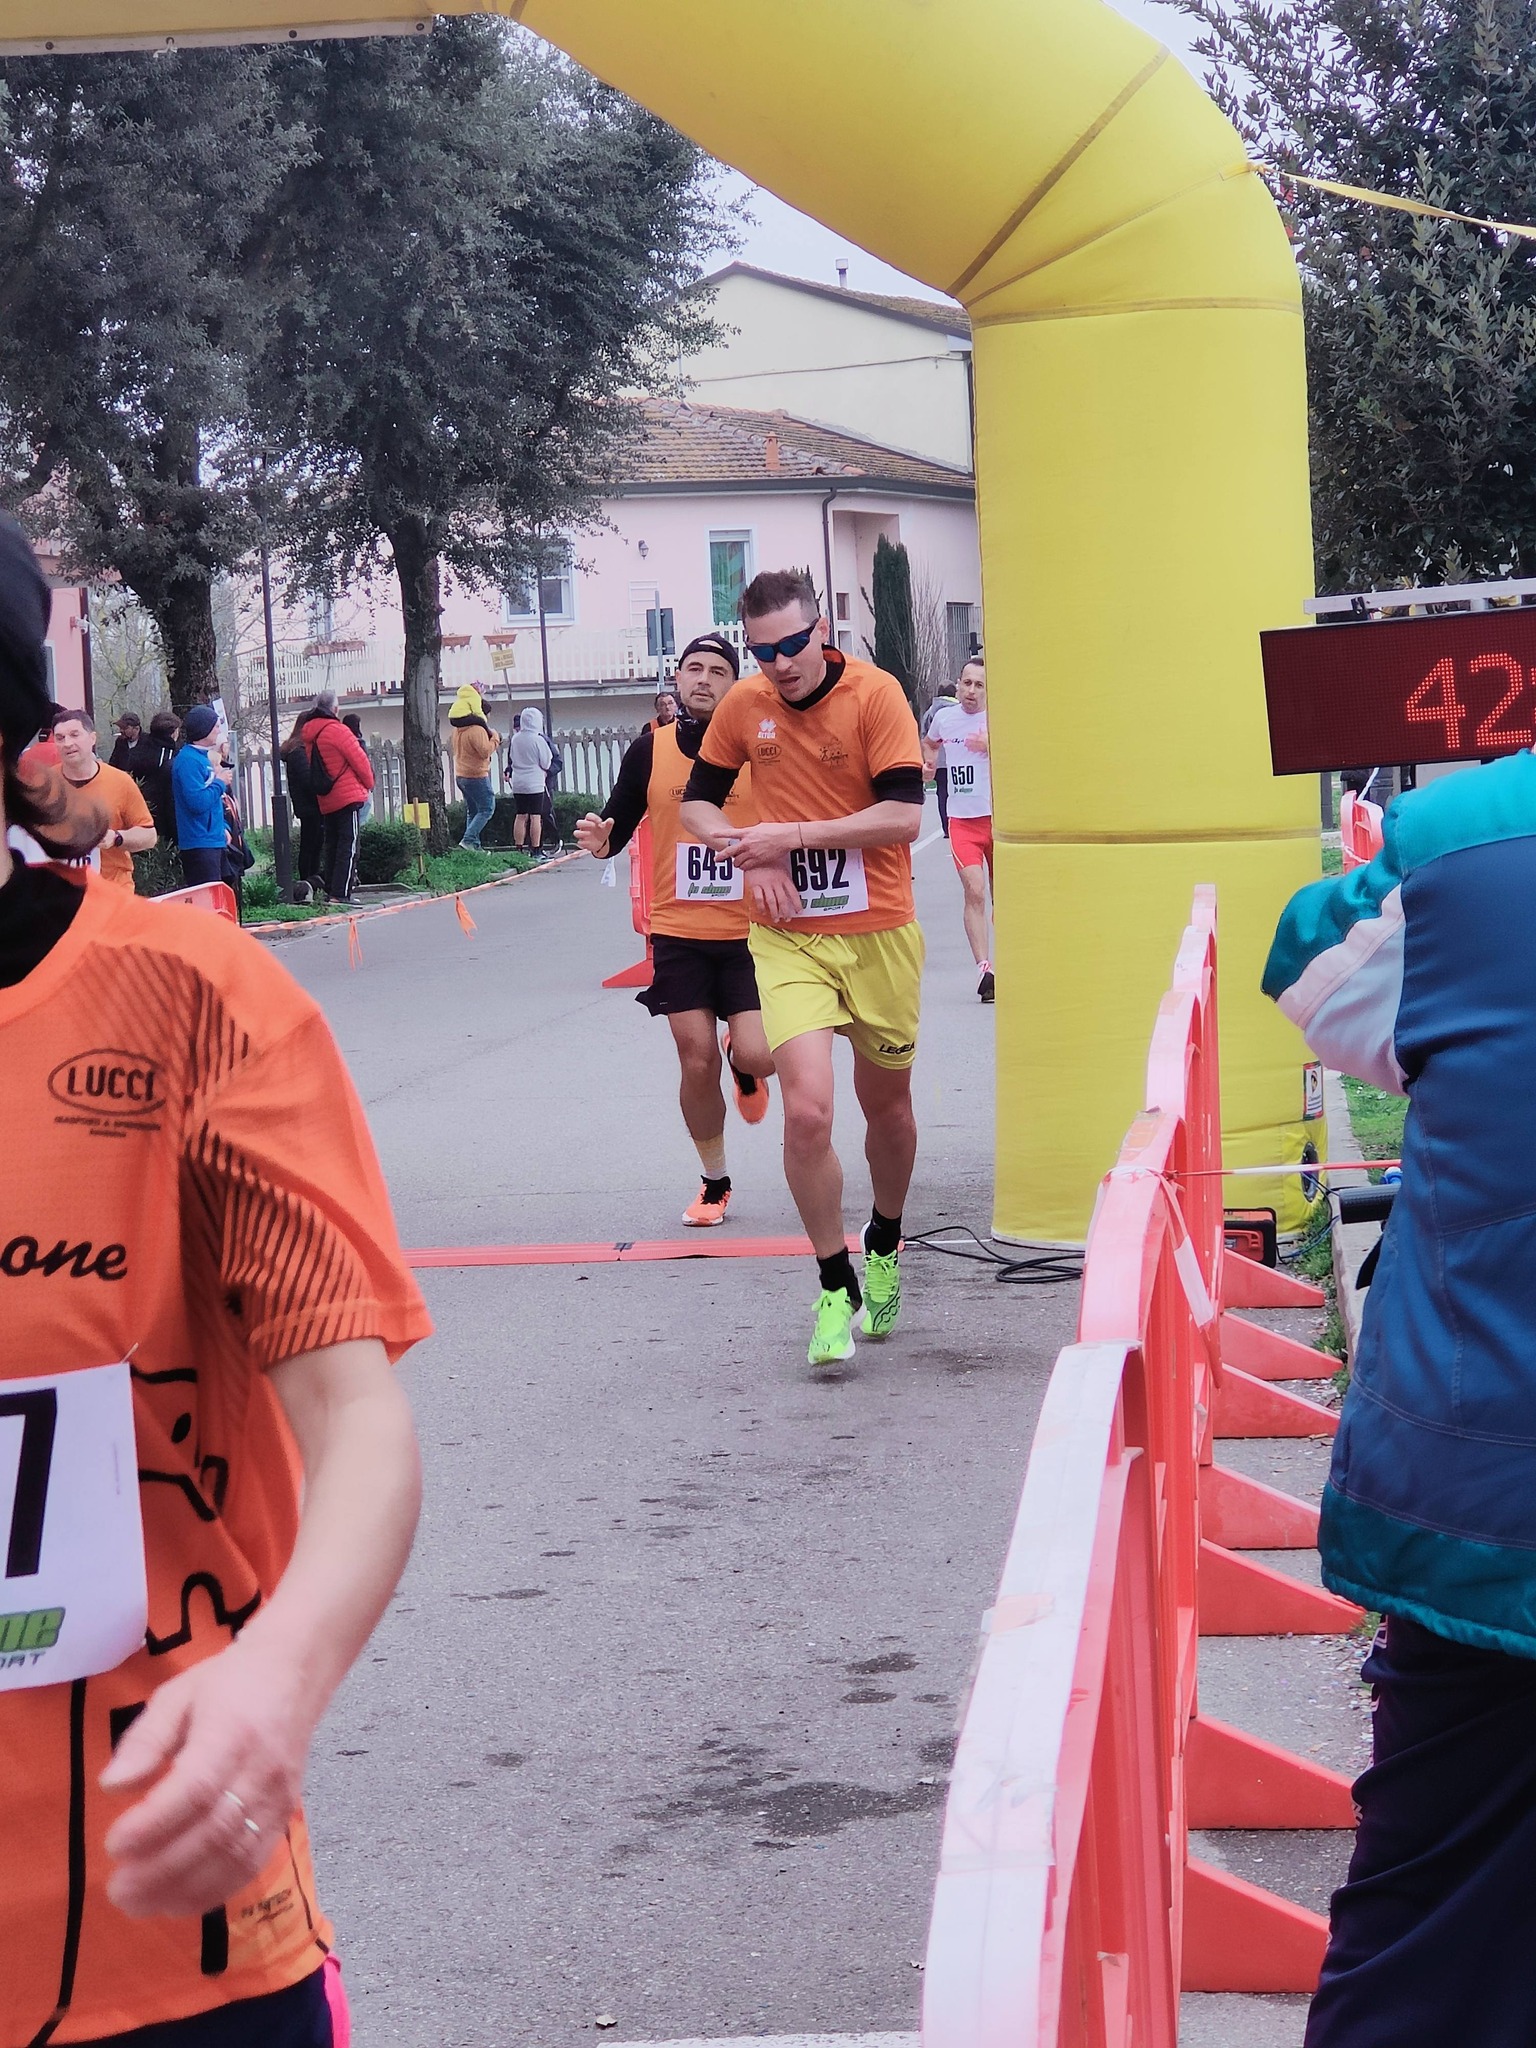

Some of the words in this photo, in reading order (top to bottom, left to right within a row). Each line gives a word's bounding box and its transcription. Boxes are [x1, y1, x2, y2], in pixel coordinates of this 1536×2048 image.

[951, 765, 974, 785] 650
[790, 847, 850, 892] 692
[67, 1064, 156, 1102] LUCCI
[0, 1234, 128, 1281] one
[0, 1387, 57, 1580] 7
